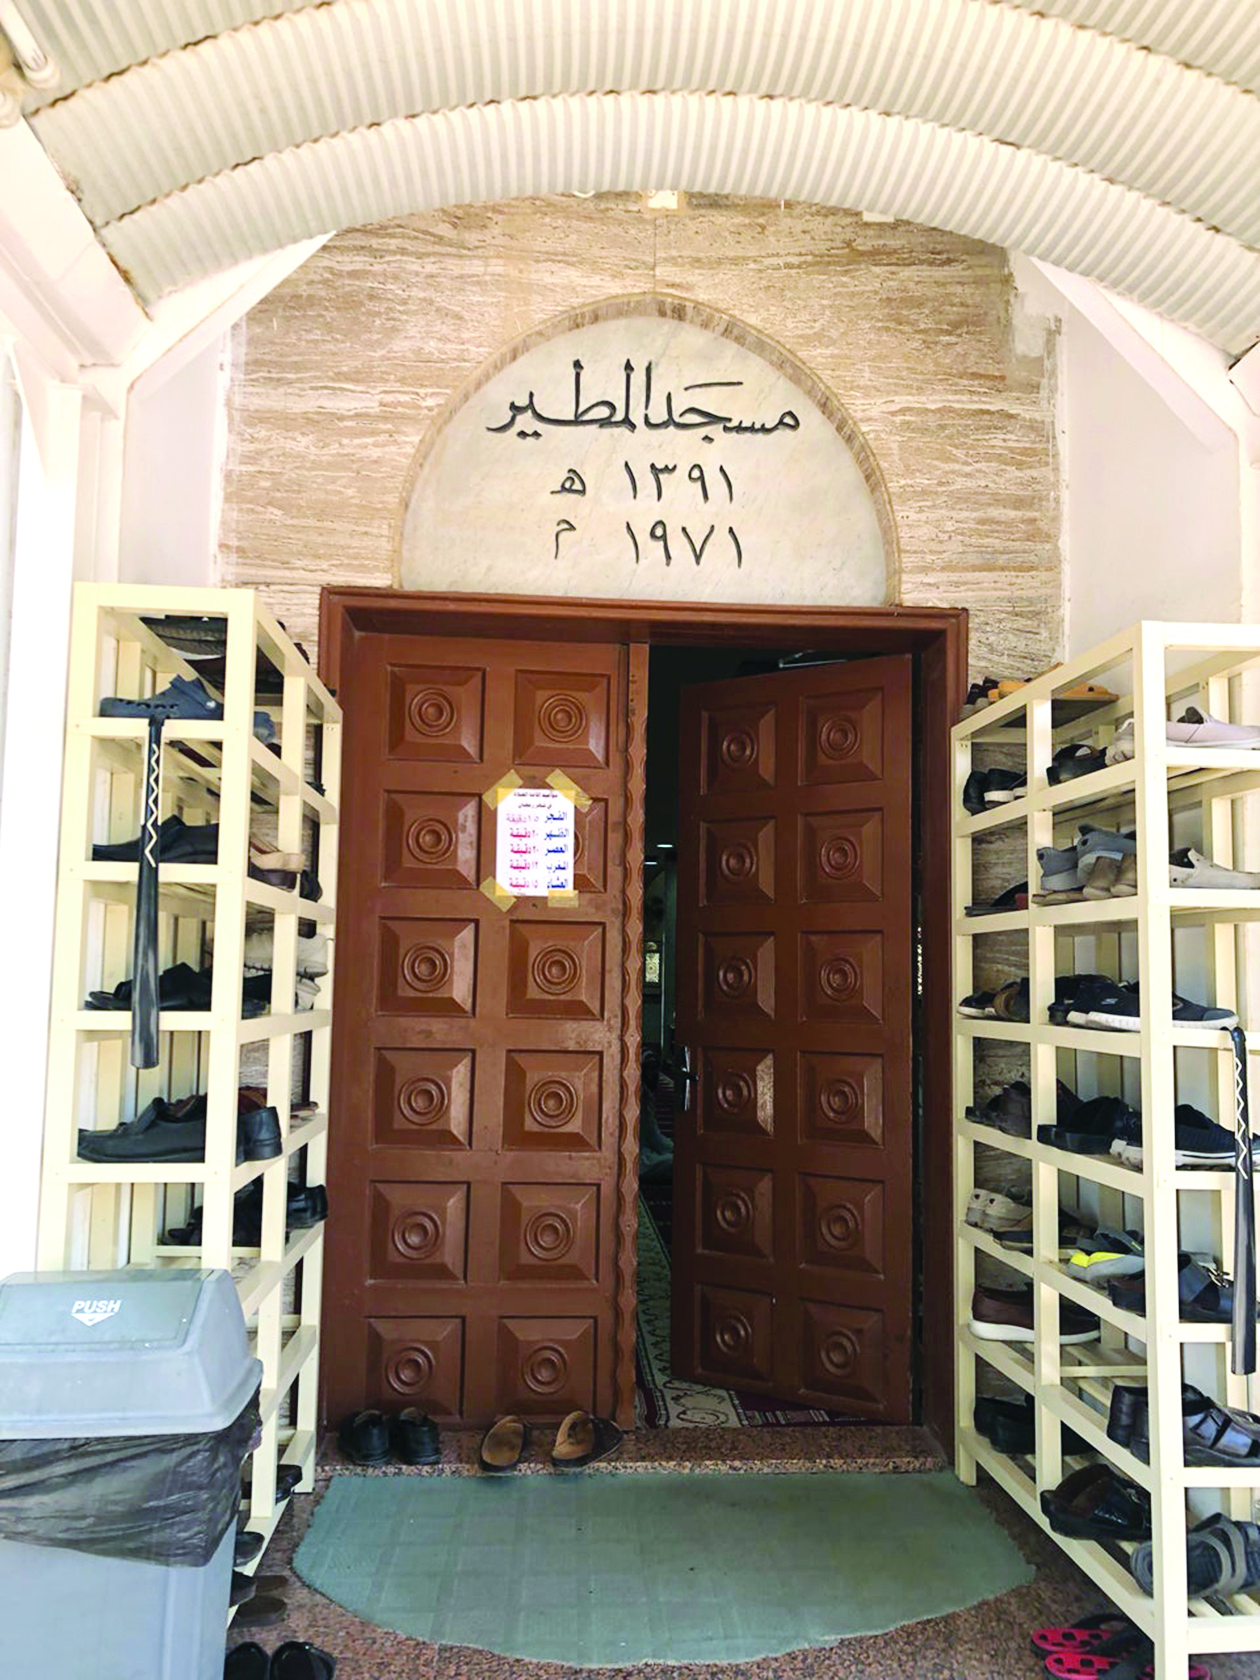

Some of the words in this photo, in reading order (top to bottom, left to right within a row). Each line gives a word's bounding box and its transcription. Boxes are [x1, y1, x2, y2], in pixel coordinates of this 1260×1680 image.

[486, 359, 652, 441] المطير
[644, 381, 800, 444] مسجد
[624, 460, 735, 504] ١٣٩١
[554, 519, 577, 560] م
[625, 519, 743, 569] ١٩٧١
[544, 811, 568, 824] الفجر
[544, 828, 569, 841] الظهر
[545, 844, 568, 856] العصر
[546, 860, 569, 873] المغرب
[547, 876, 569, 889] العشاء
[71, 1300, 122, 1314] PUSH
